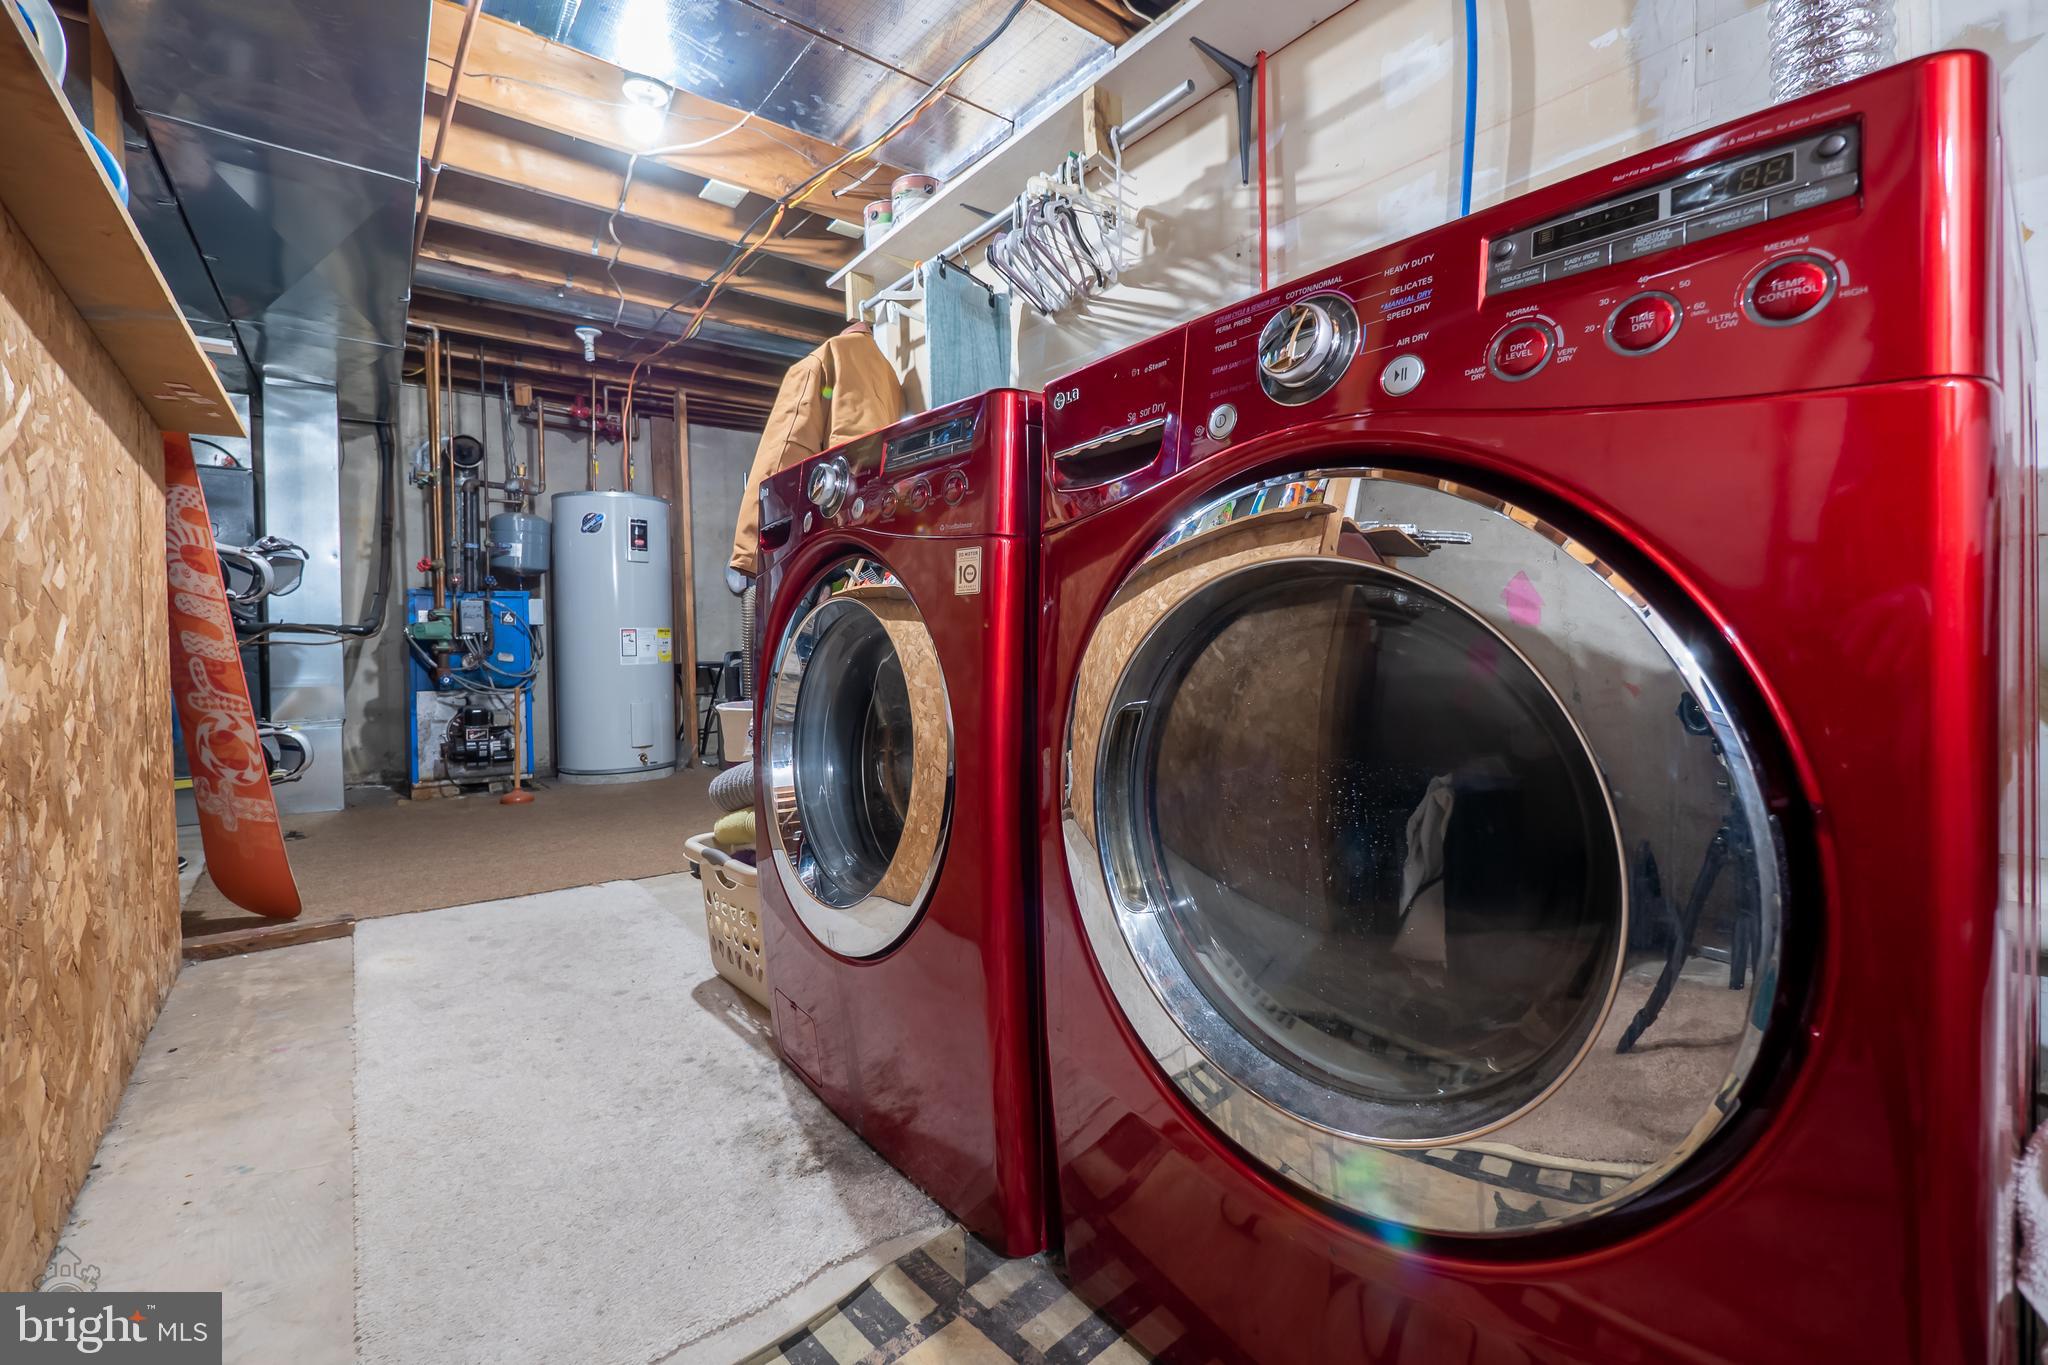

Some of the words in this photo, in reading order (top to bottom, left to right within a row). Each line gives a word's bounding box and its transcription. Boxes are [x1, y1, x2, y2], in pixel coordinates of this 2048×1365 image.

[1635, 228, 1671, 241] CUSTOM
[1763, 235, 1810, 252] MEDIUM
[1564, 255, 1582, 266] EASY
[1582, 250, 1600, 261] IRON
[1383, 262, 1410, 277] HEAVY
[1411, 253, 1435, 268] DUTY
[1285, 275, 1343, 300] COTTON/NORMAL
[1389, 275, 1433, 296] DELICATES
[1679, 279, 1691, 289] 50
[1416, 288, 1433, 299] DRY
[1758, 284, 1819, 305] CONTROL
[1838, 285, 1869, 299] HIGH
[1598, 298, 1610, 306] 30
[1693, 301, 1706, 310] 60
[1386, 306, 1412, 321] SPEED
[1413, 301, 1431, 314] DRY
[1505, 304, 1540, 318] NORMAL
[1630, 311, 1656, 324] TIME
[1707, 311, 1739, 324] ULTRA
[1215, 321, 1233, 334] PERM.
[1233, 316, 1253, 328] PRESS
[1584, 324, 1596, 333] 20
[1631, 320, 1654, 333] DRY
[1715, 319, 1739, 330] LOW
[1214, 338, 1238, 353] TOWELS
[1395, 336, 1410, 347] AIR
[1411, 331, 1430, 343] DRY
[1509, 342, 1528, 353] DRY
[1556, 346, 1578, 357] VERY
[1505, 349, 1533, 361] LEVEL
[1556, 354, 1574, 364] DRY
[1464, 365, 1487, 376] DAMP
[1470, 372, 1486, 382] DRY
[1127, 407, 1151, 422] Sesor
[1152, 402, 1167, 414] Dry
[958, 564, 977, 585] 10
[165, 483, 277, 833] forum
